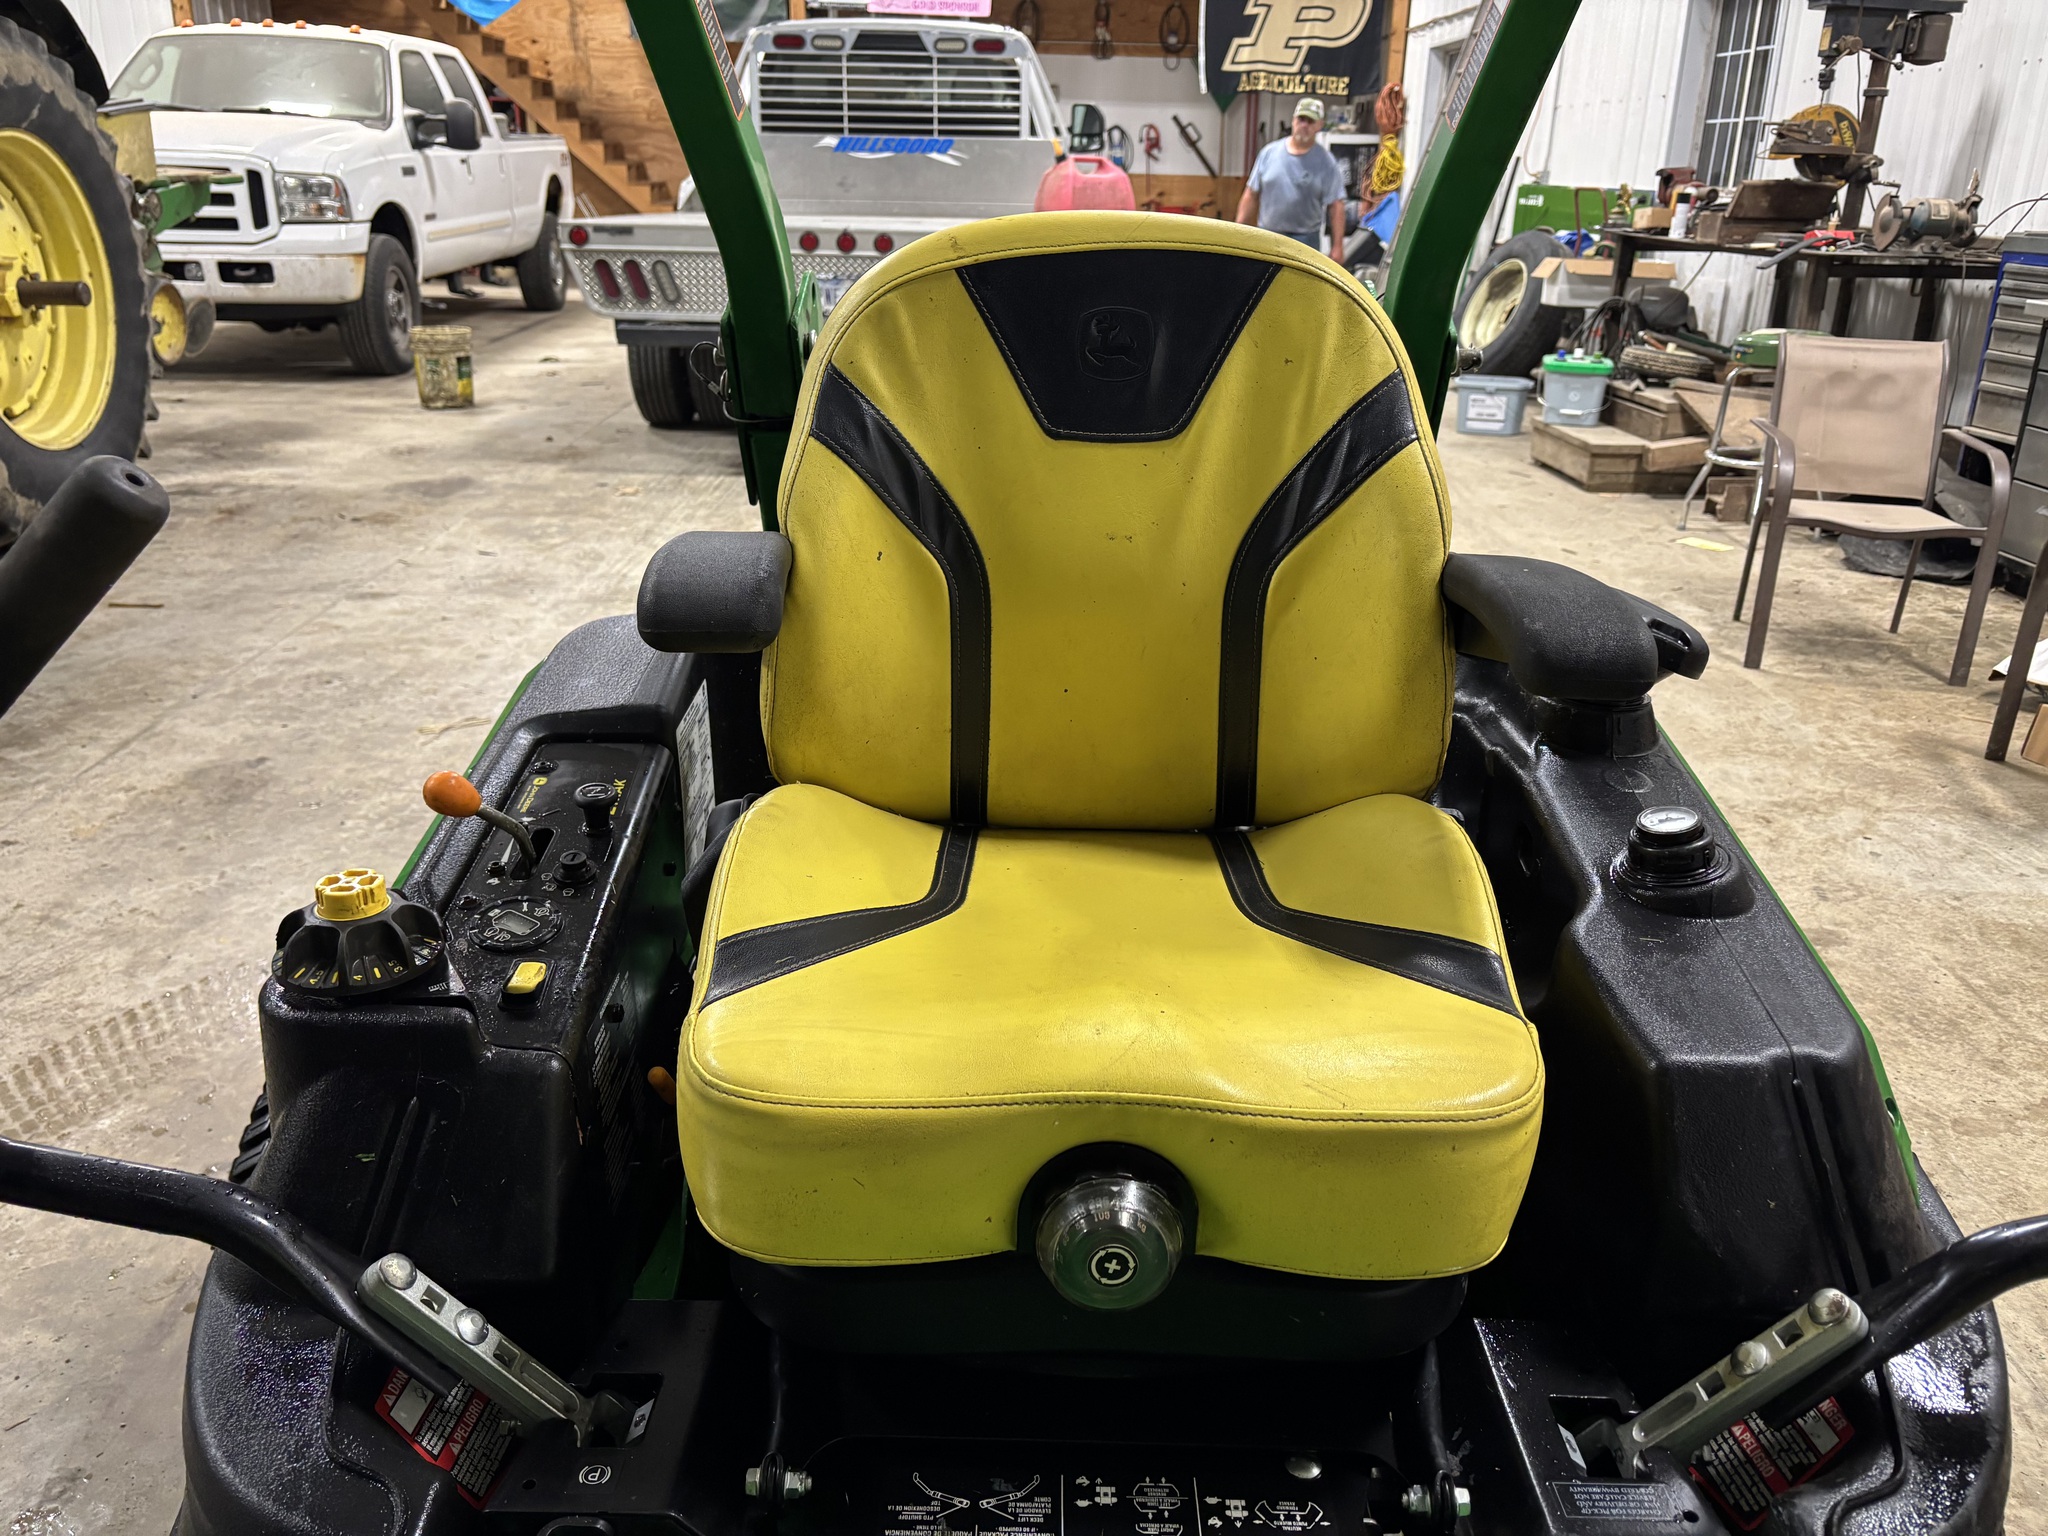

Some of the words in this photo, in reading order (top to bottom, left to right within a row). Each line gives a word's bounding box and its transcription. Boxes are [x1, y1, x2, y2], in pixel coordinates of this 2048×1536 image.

[1221, 0, 1374, 73] P
[1237, 71, 1350, 96] AGRICULTURE
[833, 136, 955, 154] HILLSBORO
[391, 1370, 409, 1396] DAN
[453, 1399, 484, 1444] PELIGRO
[1818, 1399, 1847, 1431] NGER
[1739, 1432, 1775, 1478] PELIGRO
[587, 1467, 601, 1481] P
